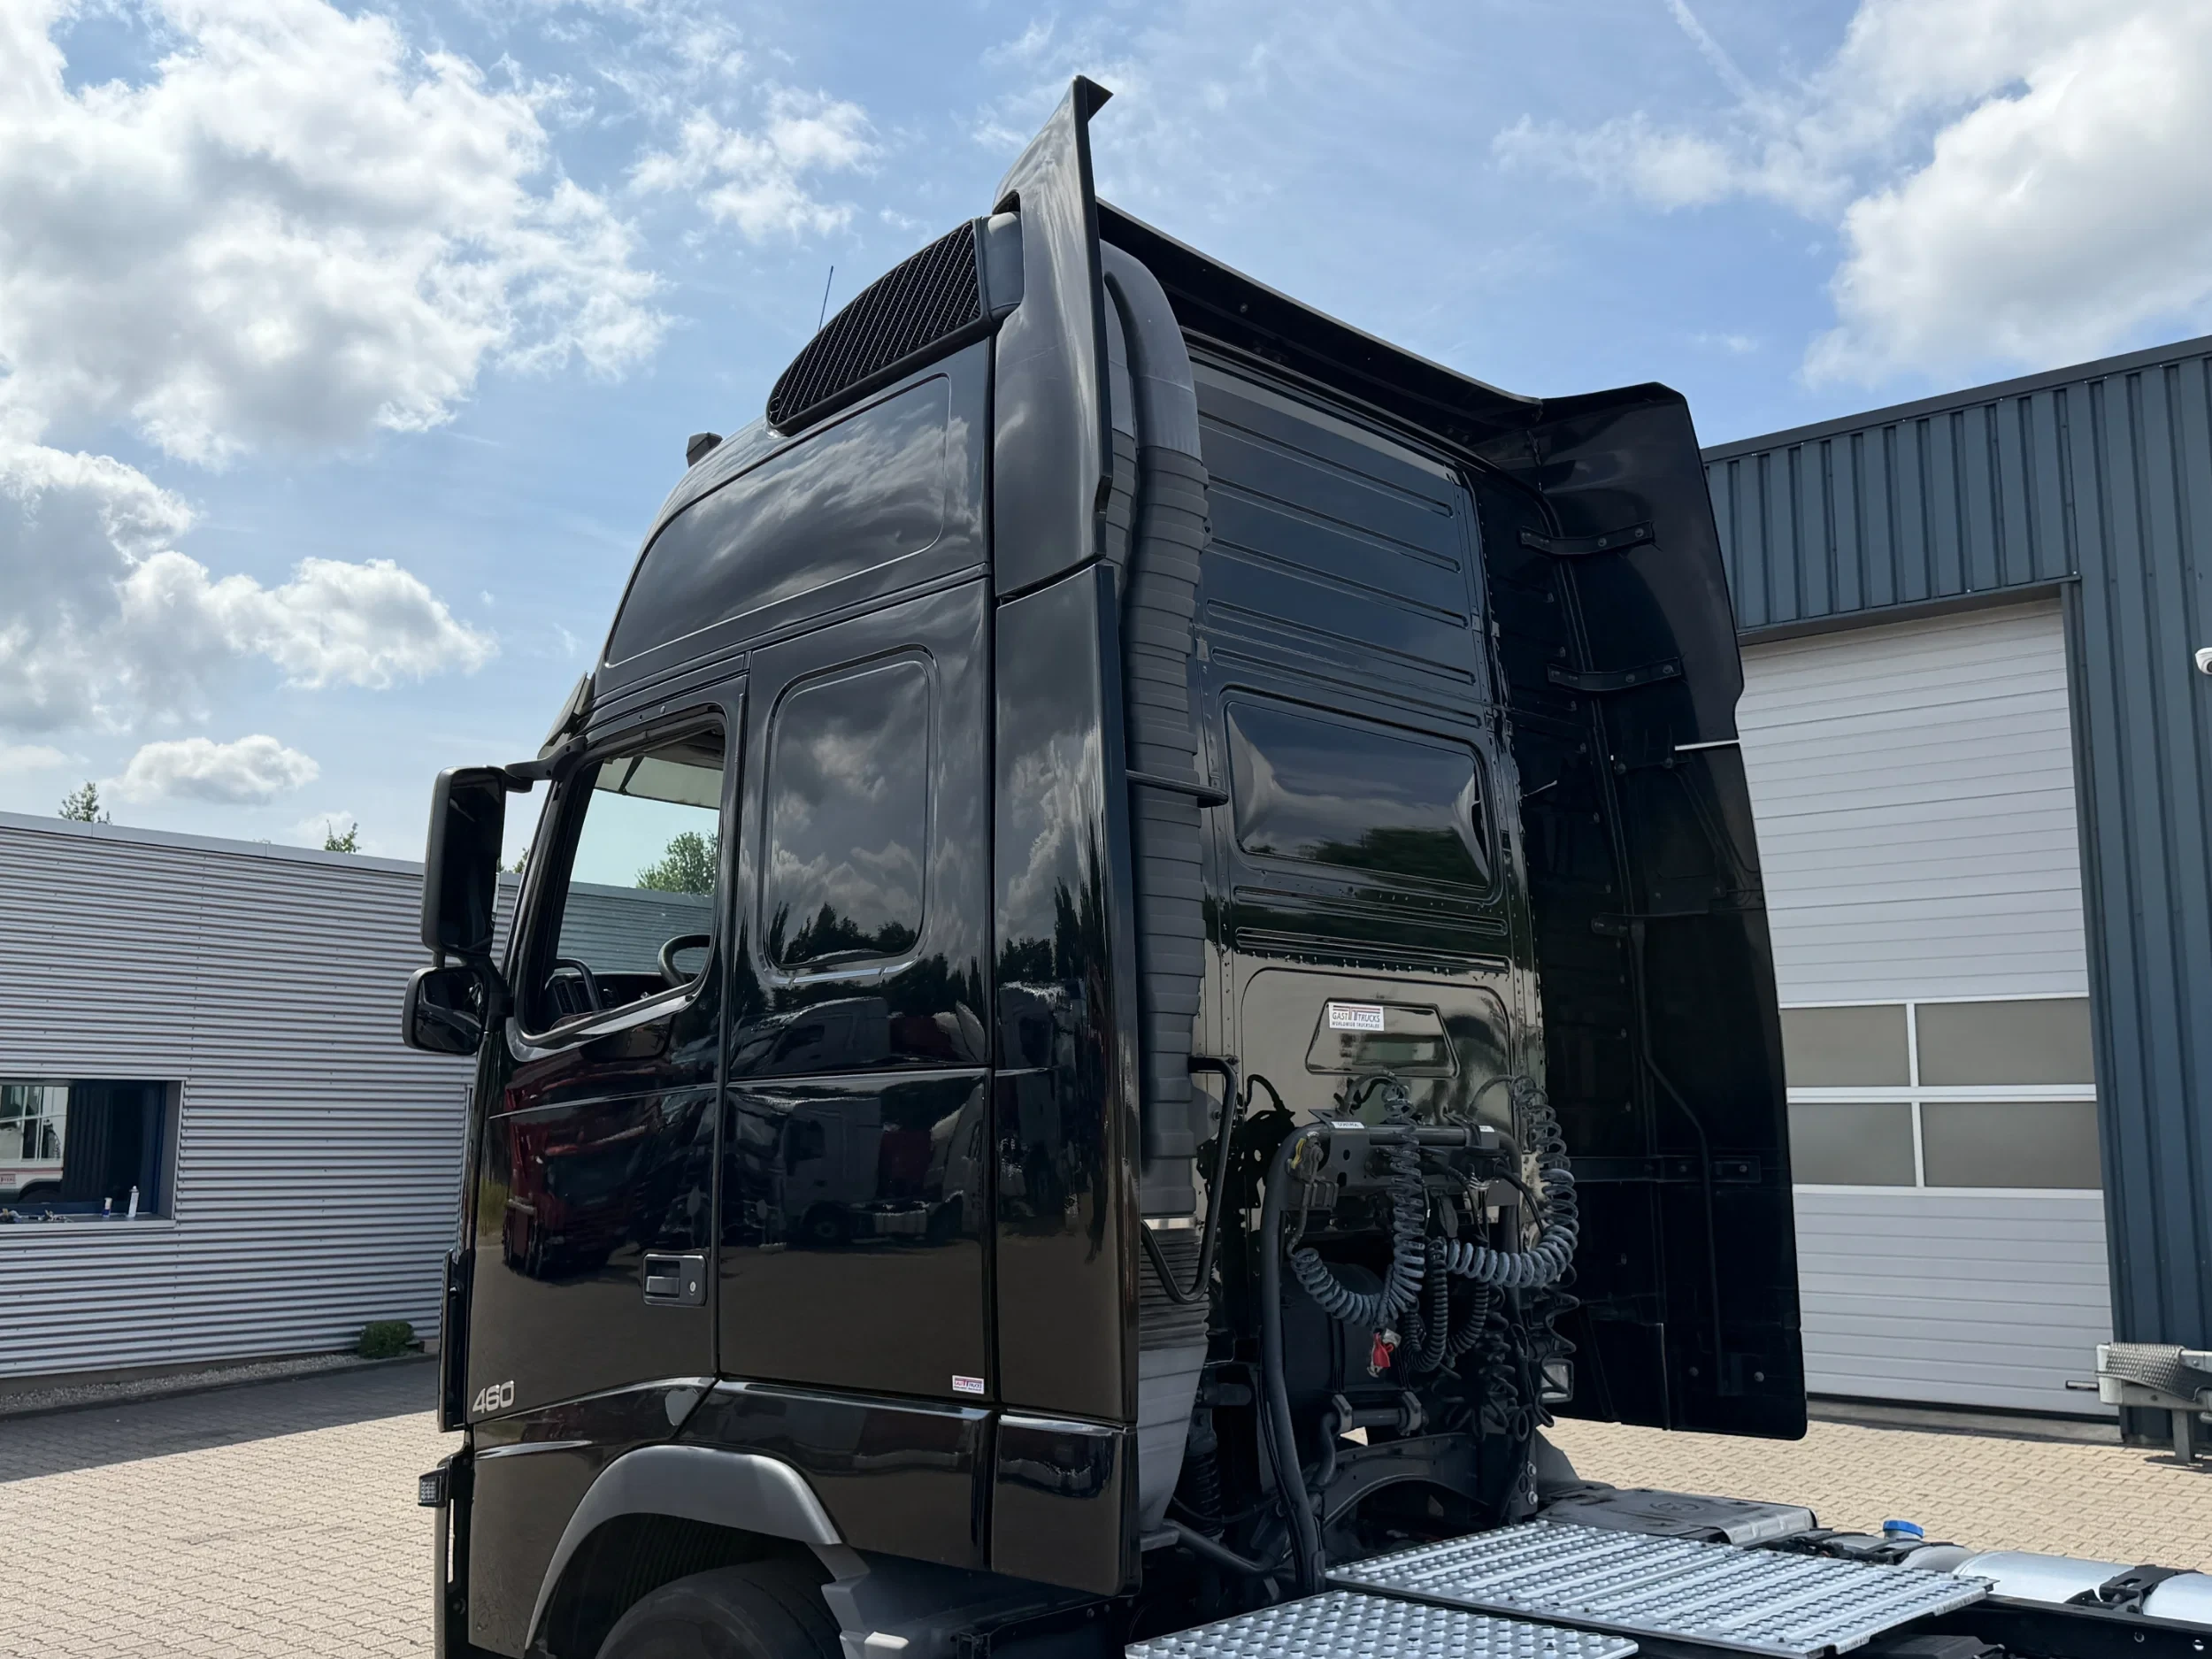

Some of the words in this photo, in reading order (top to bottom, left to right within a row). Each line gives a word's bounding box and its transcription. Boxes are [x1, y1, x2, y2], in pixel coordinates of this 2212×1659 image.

[1333, 1011, 1348, 1020] GAST
[1358, 1014, 1380, 1023] TRUCKS
[472, 1380, 515, 1414] 460
